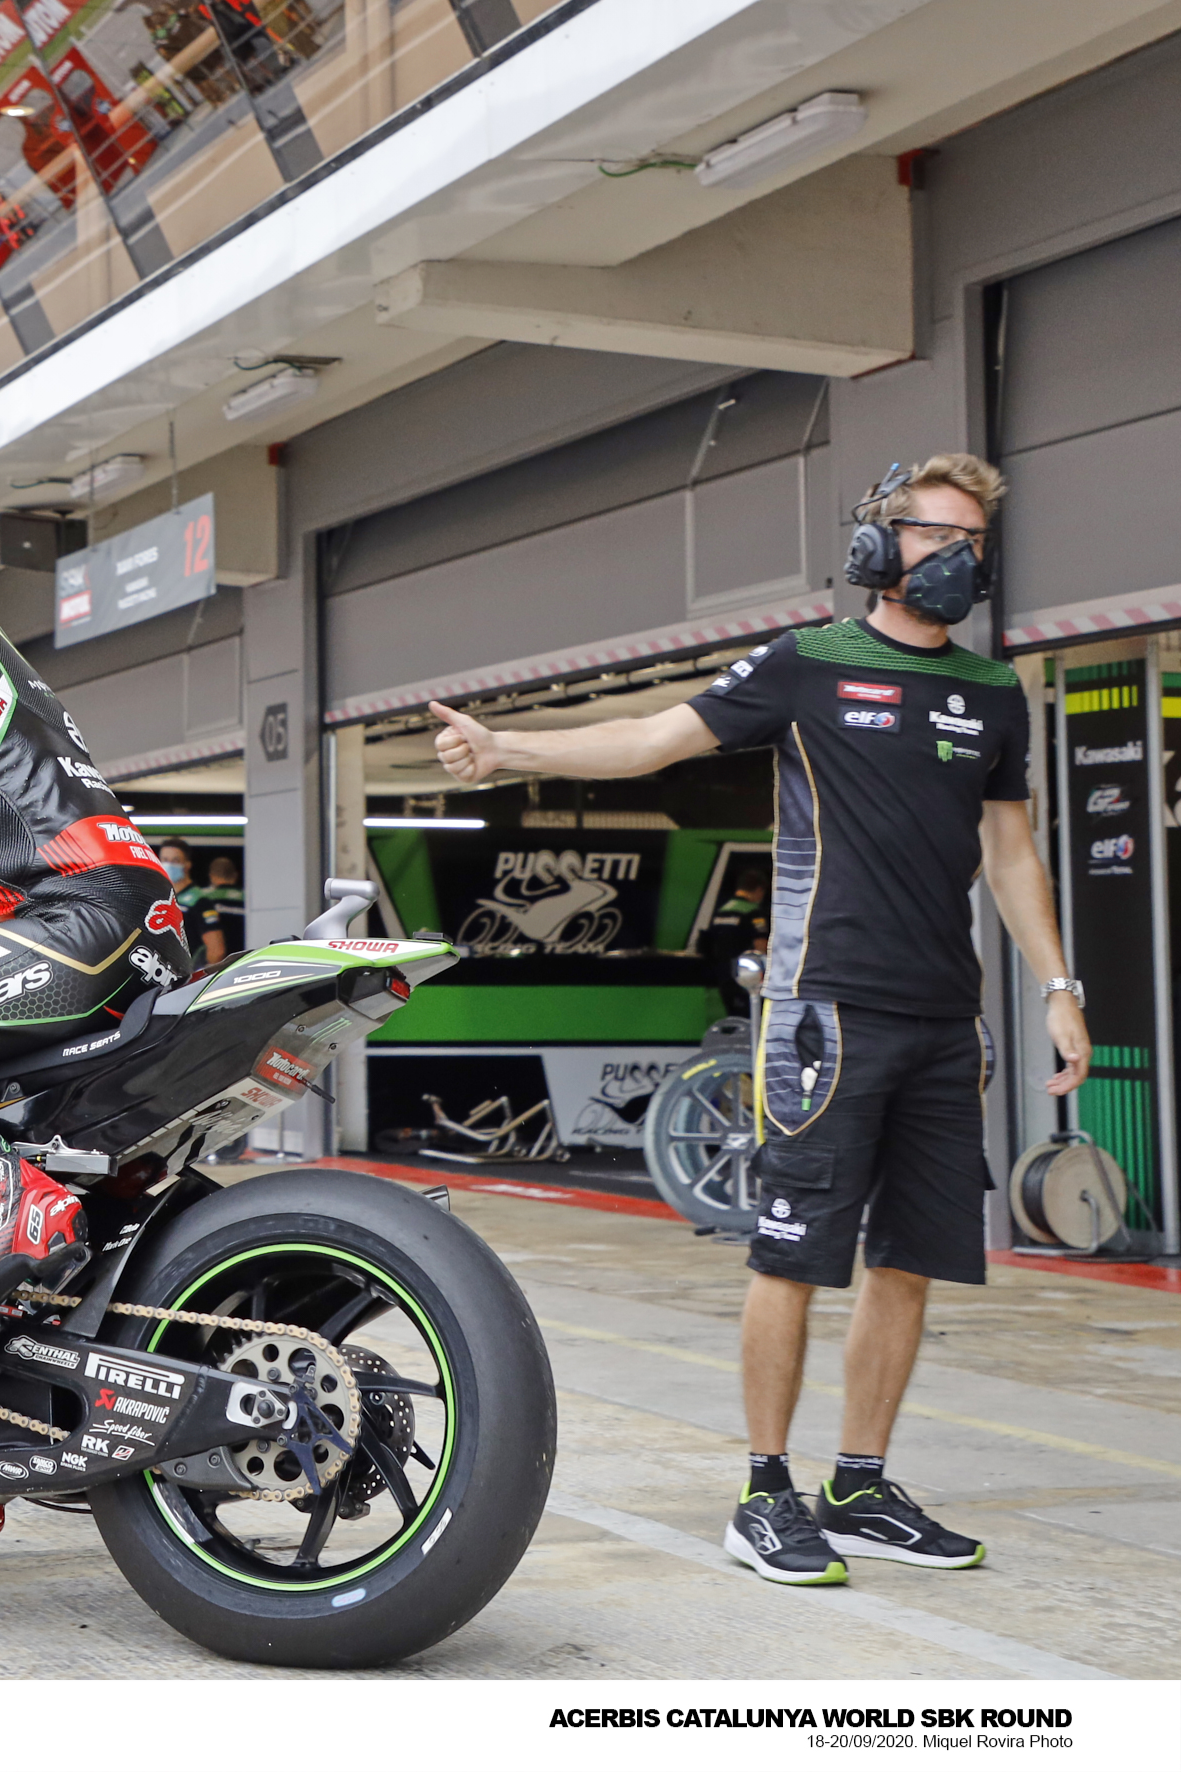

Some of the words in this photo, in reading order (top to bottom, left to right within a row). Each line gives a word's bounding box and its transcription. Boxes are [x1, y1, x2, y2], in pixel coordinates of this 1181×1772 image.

[184, 514, 211, 577] 12
[844, 711, 877, 724] elf
[928, 711, 984, 731] Kawasaki
[267, 713, 286, 753] 05
[1075, 741, 1144, 766] Kawasaki
[1091, 839, 1116, 860] elf
[327, 940, 399, 954] SHOWA
[63, 1044, 89, 1057] RACE
[89, 1030, 121, 1051] SEATS
[28, 1205, 43, 1244] 65
[84, 1352, 186, 1400] PIRELLI
[81, 1434, 111, 1453] RK
[2, 1464, 24, 1476] MWR
[61, 1451, 89, 1468] NGK
